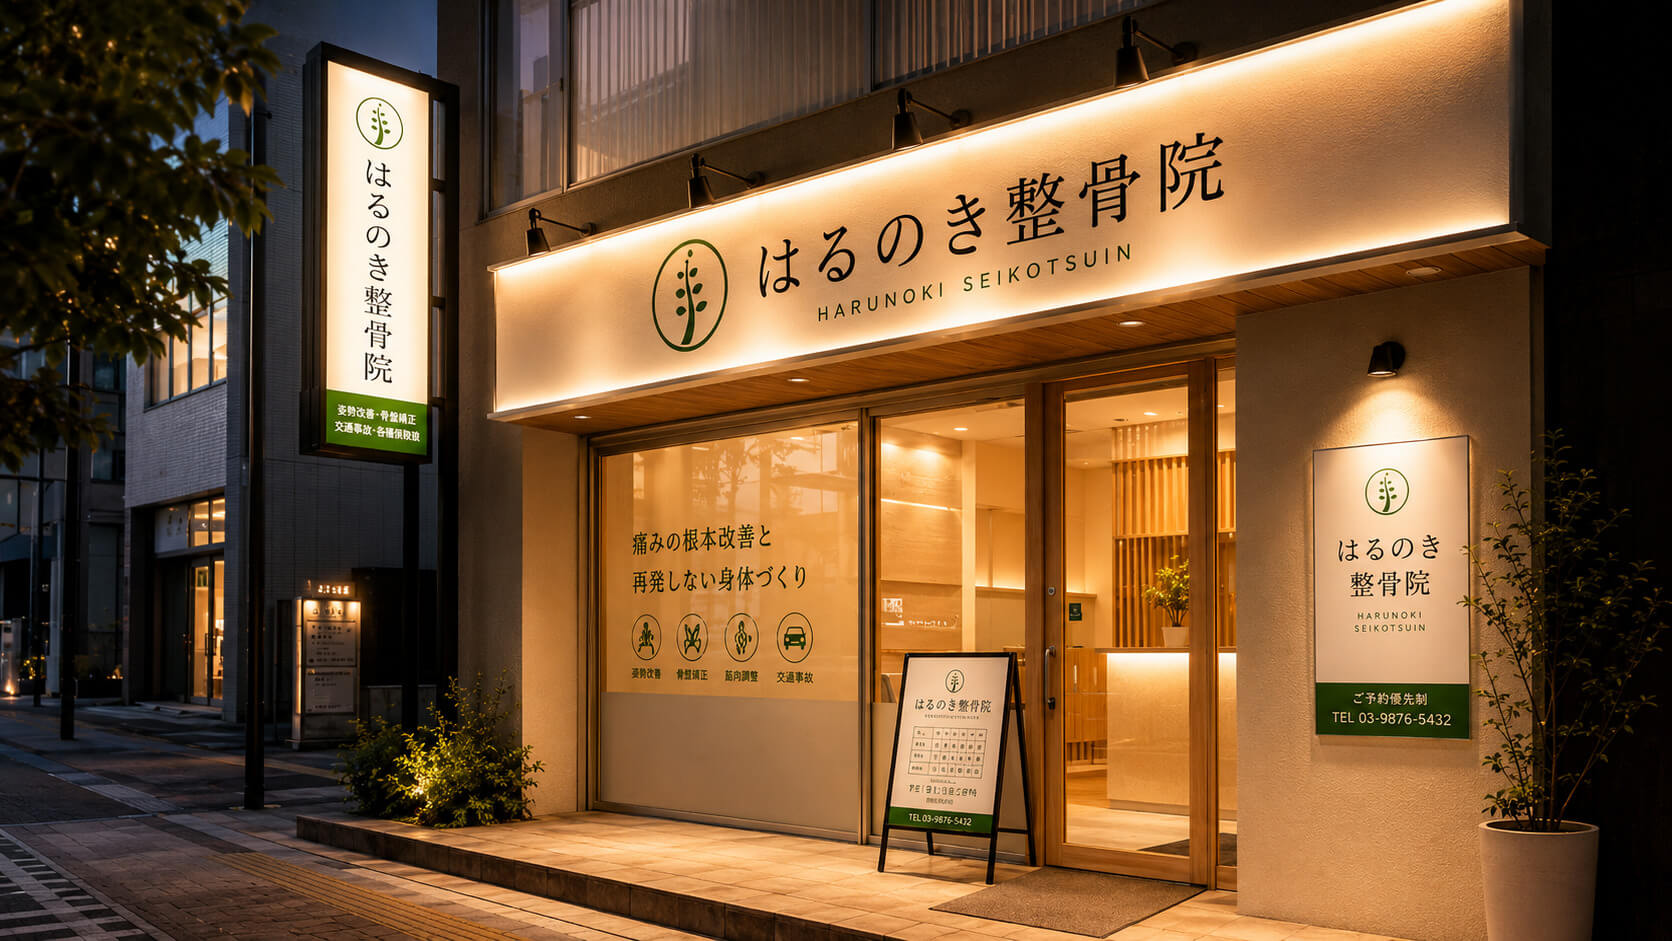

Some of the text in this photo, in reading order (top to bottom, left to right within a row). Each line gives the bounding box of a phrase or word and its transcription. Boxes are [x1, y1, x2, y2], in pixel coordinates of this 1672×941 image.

[758, 132, 1225, 298] はるのき整骨院
[364, 158, 394, 384] はるのき整骨院
[817, 243, 1133, 322] HARUNOKI SEIKOTSUIN
[632, 523, 772, 556] 痛みの根本改善と
[1337, 533, 1441, 562] はるのき
[632, 565, 807, 594] 再発しない身体づくり
[1349, 570, 1432, 598] 整骨院
[1353, 623, 1427, 633] SEIKOTSUIN
[1357, 610, 1423, 620] HARUNOKI
[914, 698, 992, 713] はるのき整骨院
[1352, 691, 1429, 706] ご予約優先制
[1331, 711, 1452, 727] TEL 03-9876-5432
[908, 813, 922, 822] TEL
